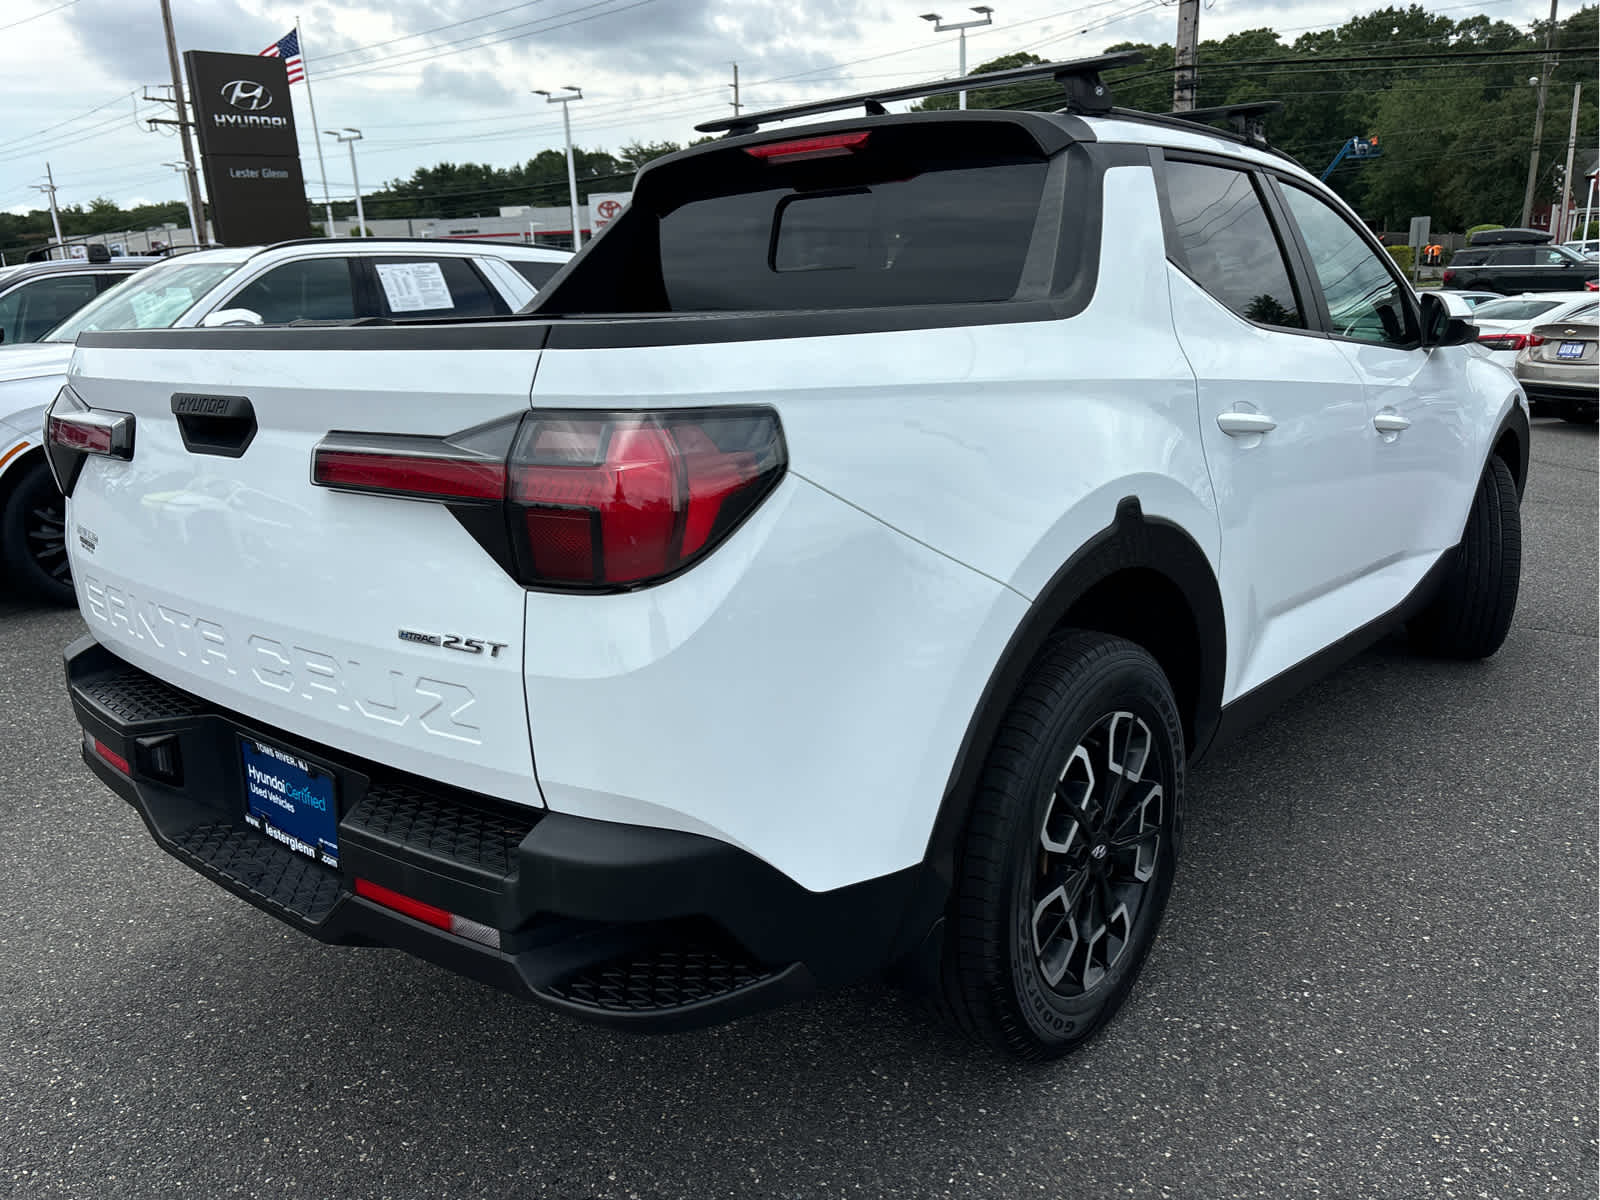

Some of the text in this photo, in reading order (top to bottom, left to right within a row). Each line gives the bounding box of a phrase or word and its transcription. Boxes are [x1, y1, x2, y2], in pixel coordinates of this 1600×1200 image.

[213, 113, 287, 128] HYUNDAI
[229, 167, 289, 179] Lester Glenn
[177, 396, 230, 413] HYUNDAI
[399, 630, 441, 646] HTRAC
[85, 575, 483, 745] SANTA CRUZ
[255, 742, 275, 758] TOMS
[297, 760, 309, 771] NJ
[250, 782, 268, 799] Used
[267, 791, 296, 814] Vehicles
[265, 822, 316, 859] lesterglenn
